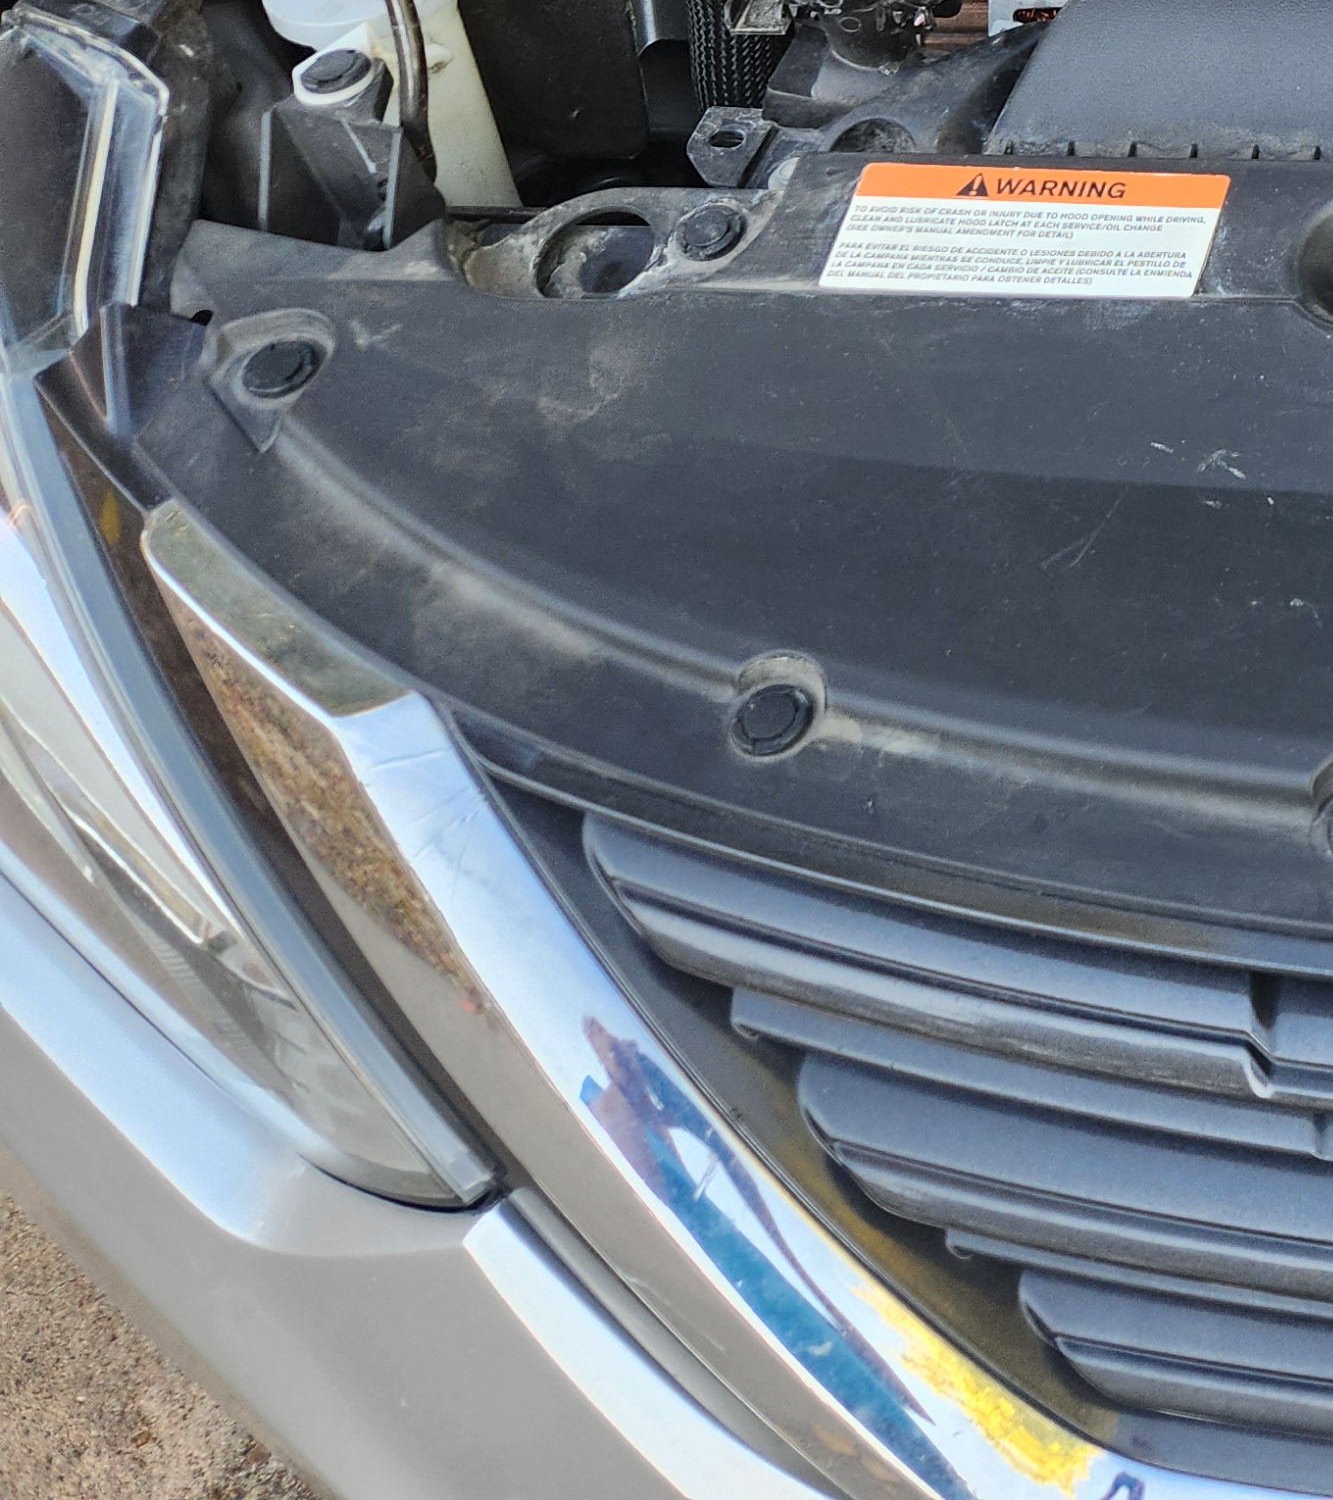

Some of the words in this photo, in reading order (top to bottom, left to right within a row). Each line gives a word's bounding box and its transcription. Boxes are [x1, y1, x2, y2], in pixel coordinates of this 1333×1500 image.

[997, 178, 1127, 199] WARNING
[938, 208, 971, 216] CRASH
[1091, 214, 1133, 222] OPENING
[905, 217, 956, 225] LUBRICATE
[958, 218, 986, 226] HOOD
[1062, 222, 1121, 231] SERVICE/OIL
[1124, 224, 1163, 232] CHANGE
[915, 226, 953, 234] MANUAL
[956, 228, 1015, 236] AMENDMENT
[1038, 231, 1074, 239] DETAIL)
[965, 247, 1018, 256] ACCIDENTE
[1020, 248, 1028, 256] O
[1030, 249, 1076, 257] LESIONES
[1077, 250, 1114, 258] DEBIDO
[1026, 258, 1056, 266] LIMPIE
[907, 273, 969, 282] PROPIETARIO
[1044, 277, 1093, 285] DETALLES)
